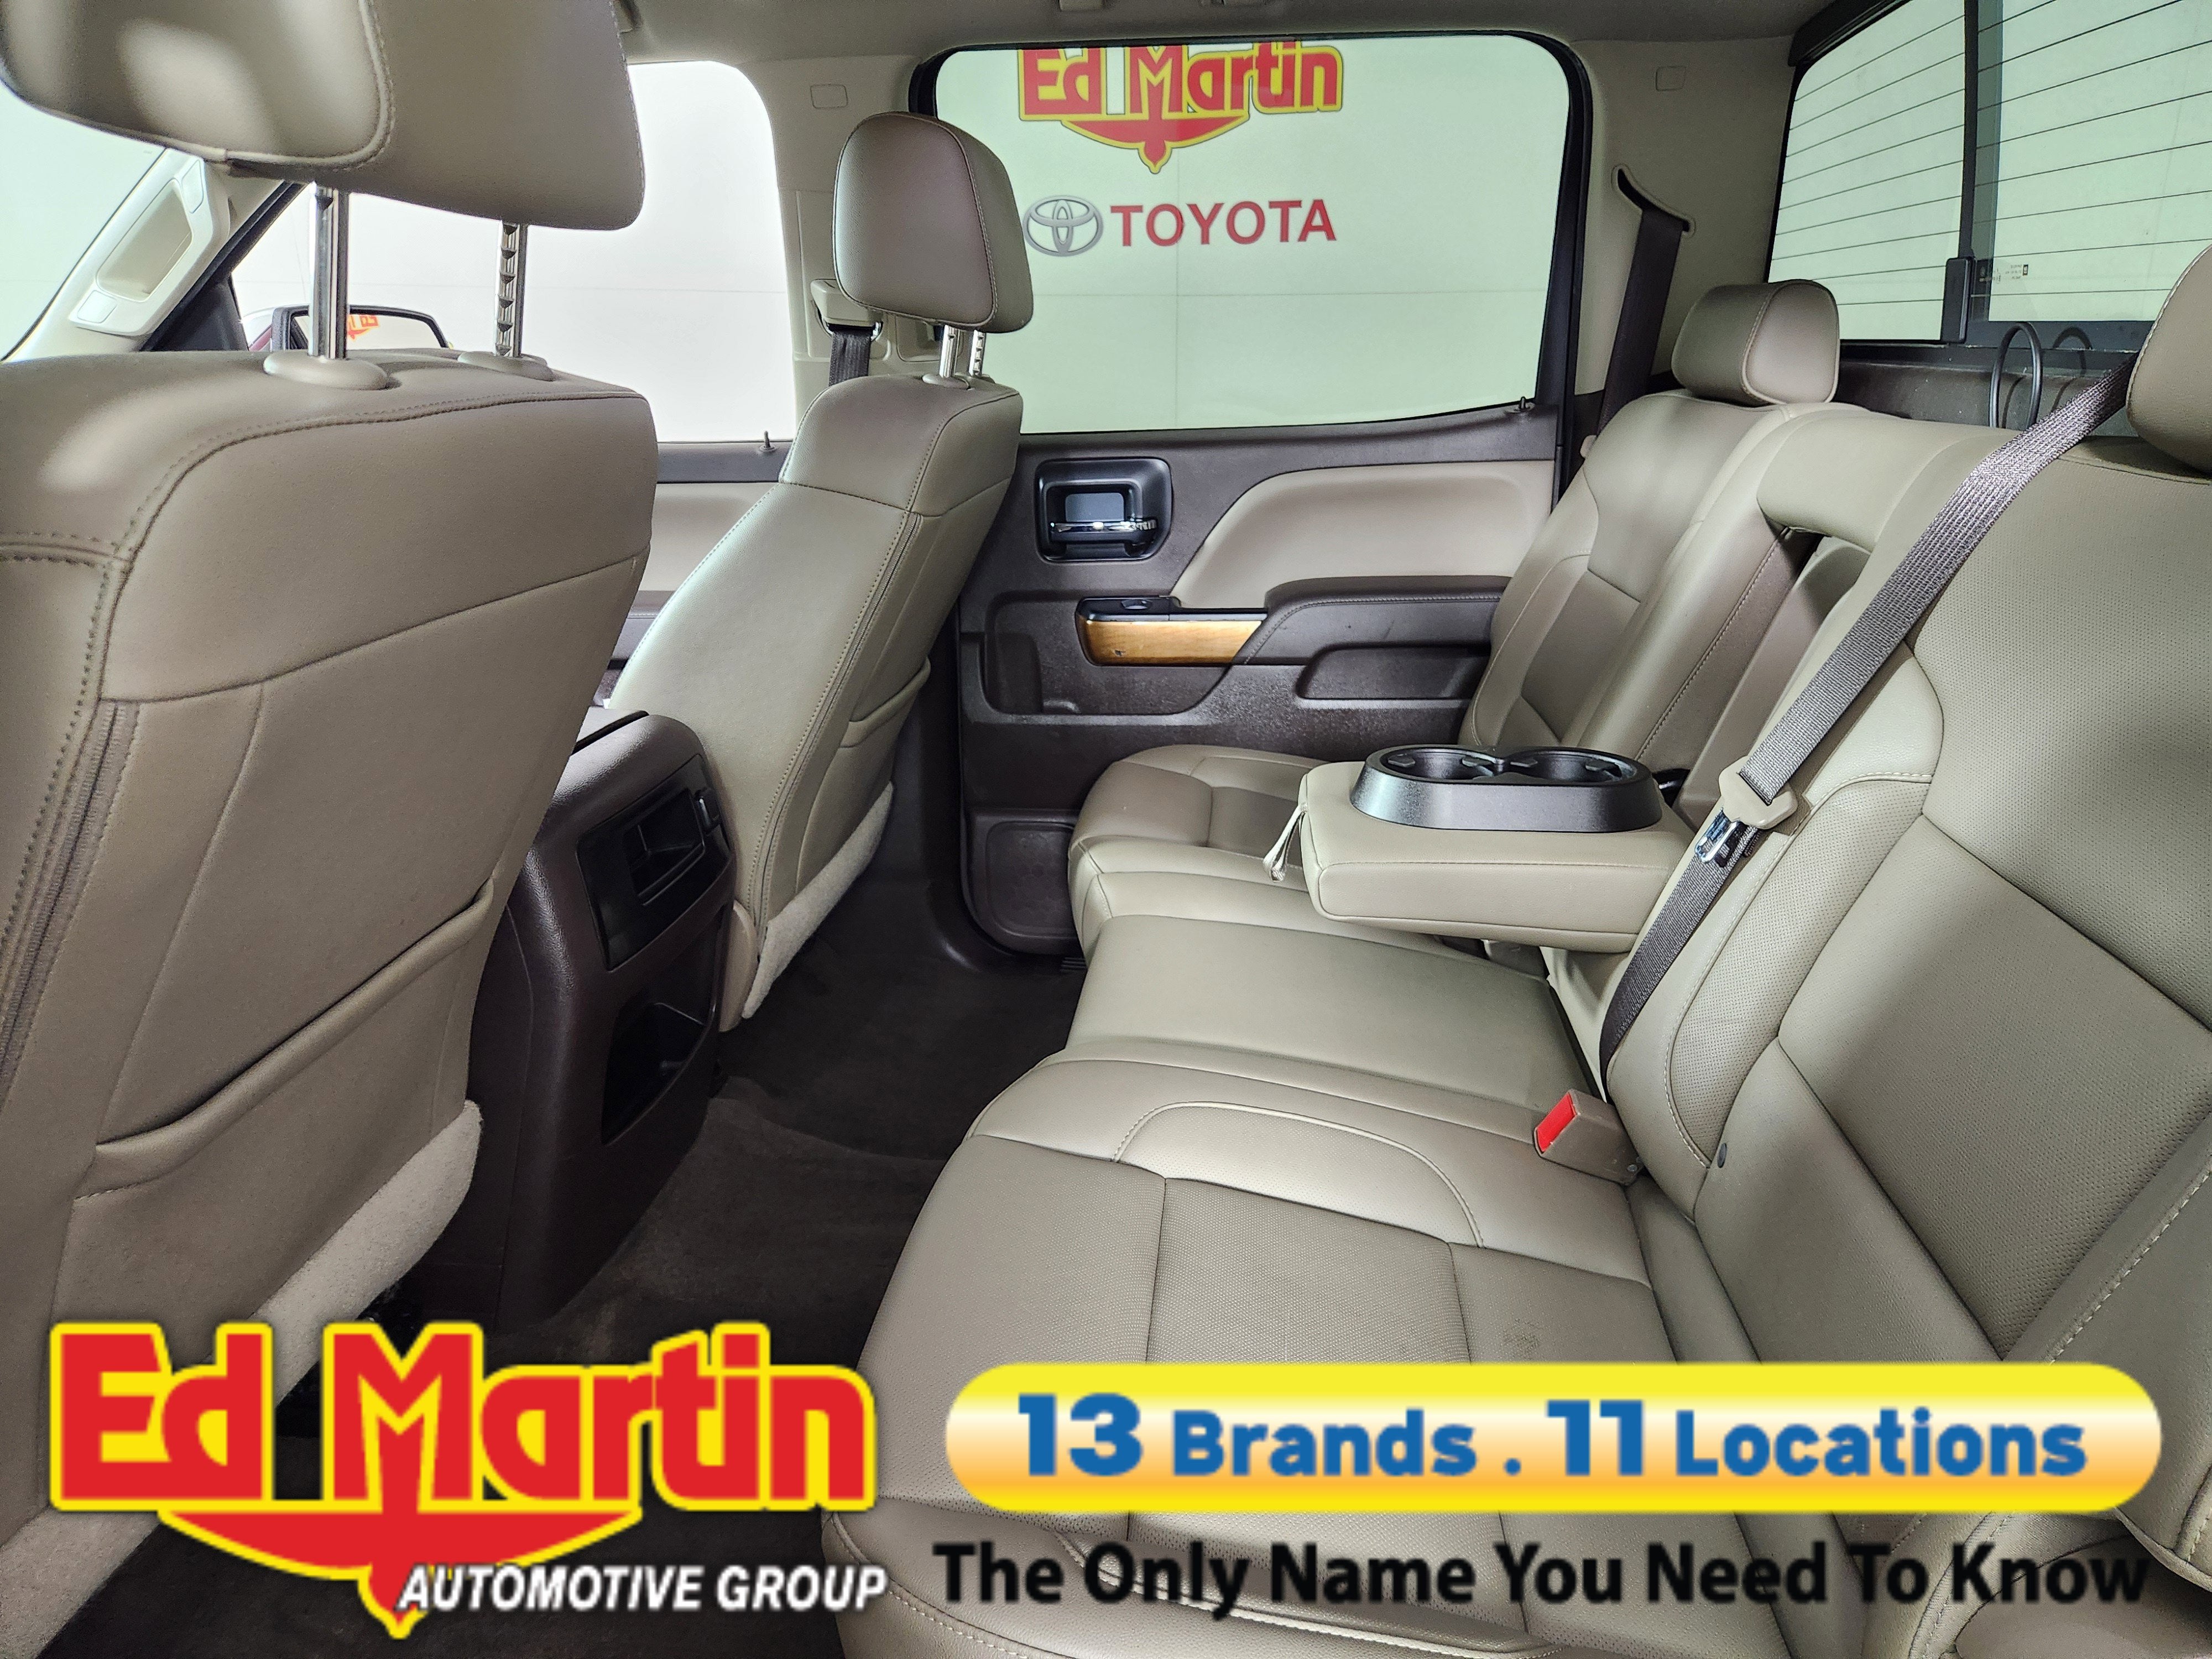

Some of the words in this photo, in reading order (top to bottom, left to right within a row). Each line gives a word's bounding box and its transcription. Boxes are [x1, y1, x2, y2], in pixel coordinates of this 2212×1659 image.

[1022, 48, 1103, 115] Ed
[1129, 41, 1338, 114] Martin
[1110, 199, 1337, 247] TOYOTA
